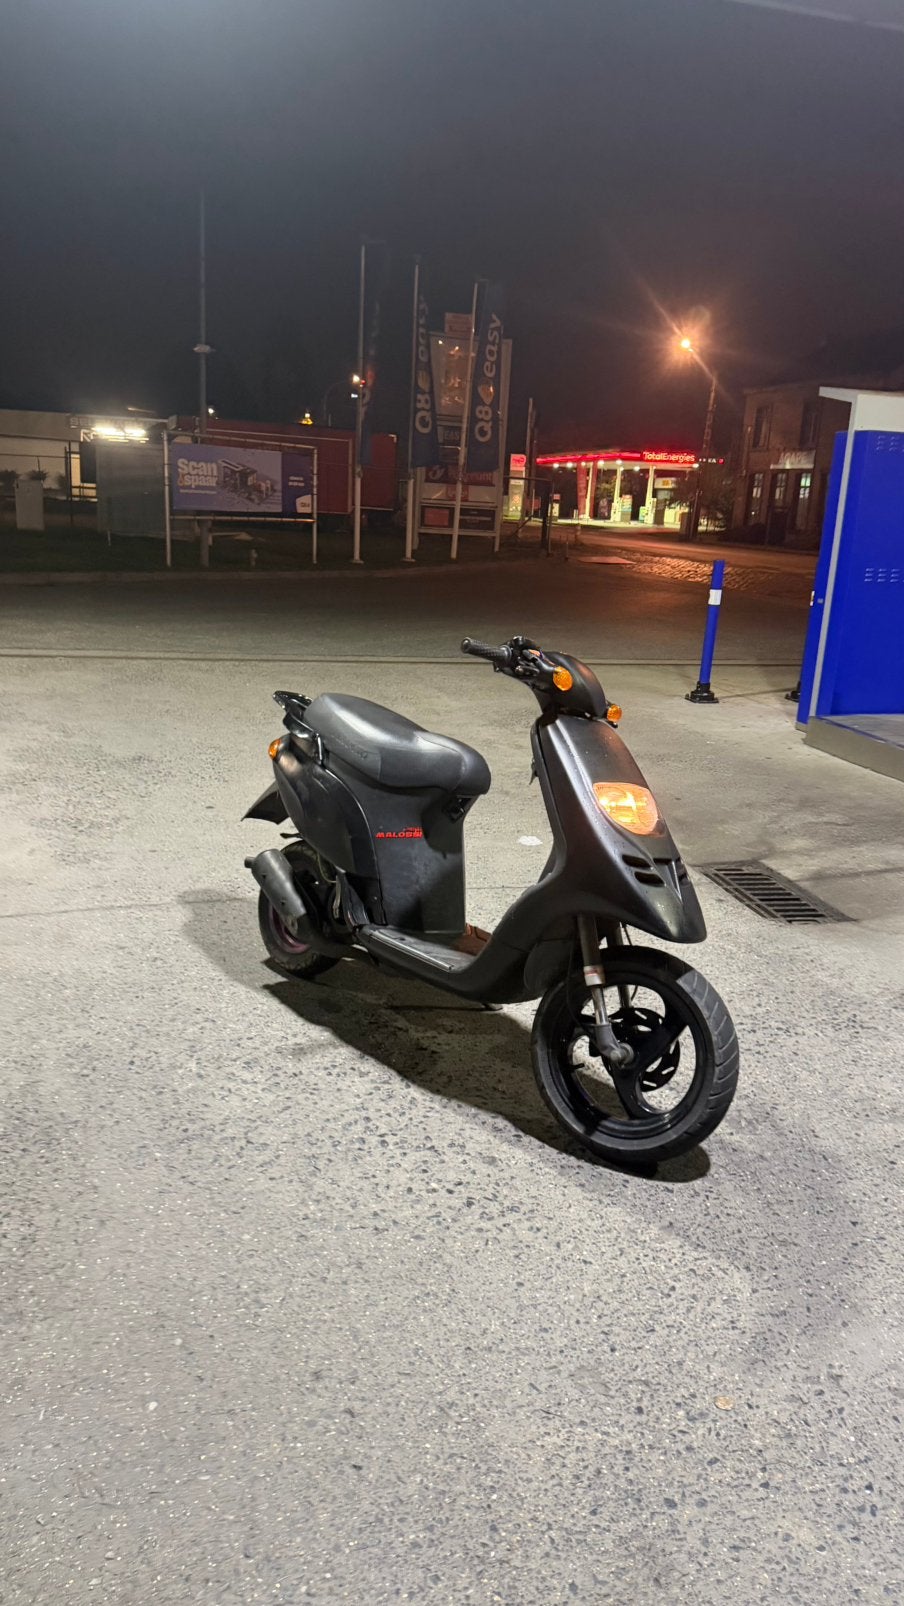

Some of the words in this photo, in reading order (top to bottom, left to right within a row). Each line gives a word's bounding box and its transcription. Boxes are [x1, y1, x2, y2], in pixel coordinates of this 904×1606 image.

[483, 313, 502, 379] easy
[415, 392, 433, 434] Q8
[474, 406, 493, 443] Q8
[177, 458, 218, 476] Scan
[643, 451, 696, 463] TotalEnergies
[376, 831, 422, 839] MALOSSI
